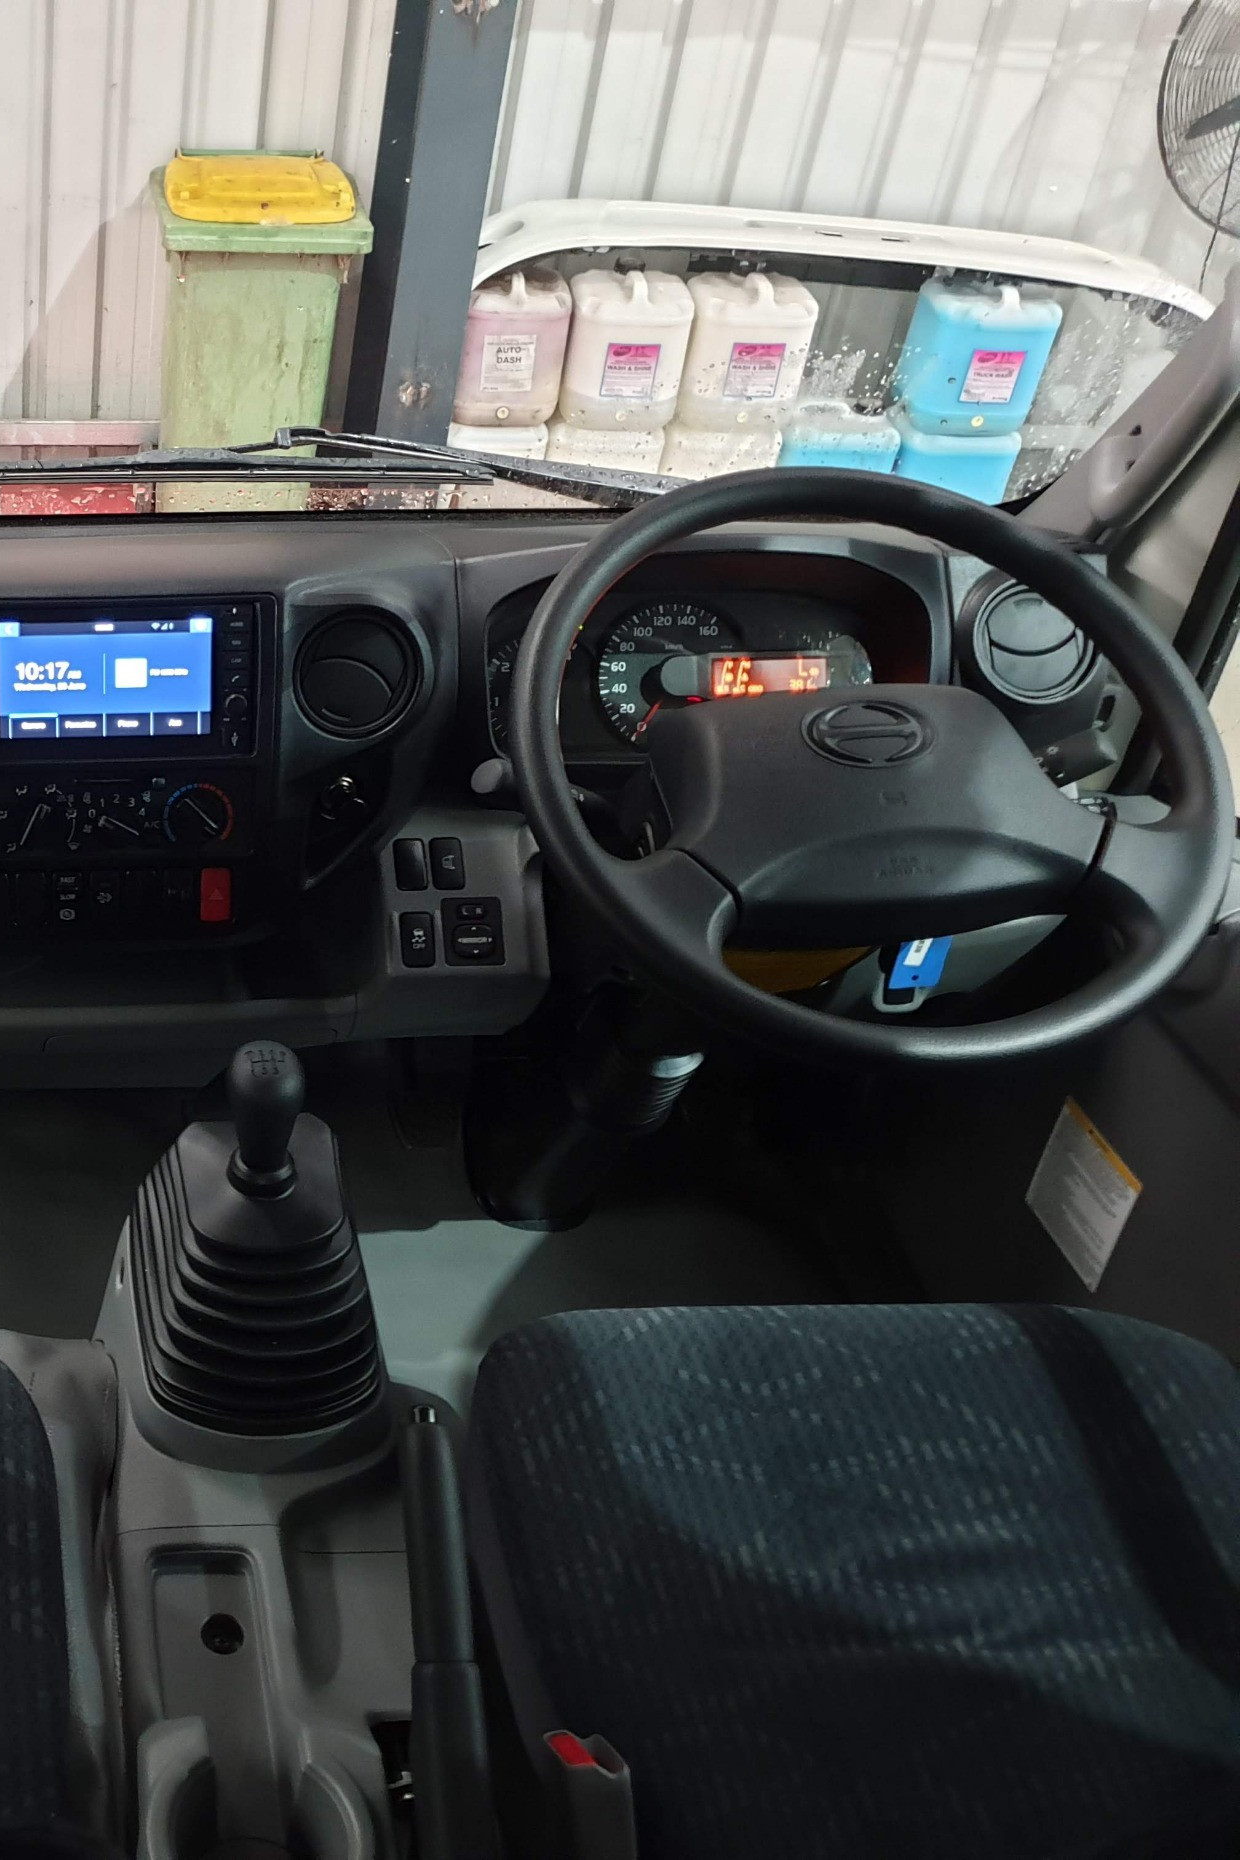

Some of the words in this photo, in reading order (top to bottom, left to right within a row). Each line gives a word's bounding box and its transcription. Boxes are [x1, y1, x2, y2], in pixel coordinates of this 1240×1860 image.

[496, 346, 522, 354] AUTO
[496, 356, 522, 364] DASH
[653, 617, 672, 626] 120
[677, 616, 697, 626] 140
[633, 627, 653, 637] 100
[699, 626, 719, 636] 160
[620, 642, 635, 652] 80
[15, 661, 70, 681] 10:17
[500, 661, 511, 674] 2
[610, 661, 627, 672] 60
[611, 683, 628, 694] 40
[620, 704, 636, 714] 20
[113, 793, 120, 803] 2
[127, 797, 135, 807] 3
[138, 807, 146, 817] 4
[143, 820, 160, 830] A/C
